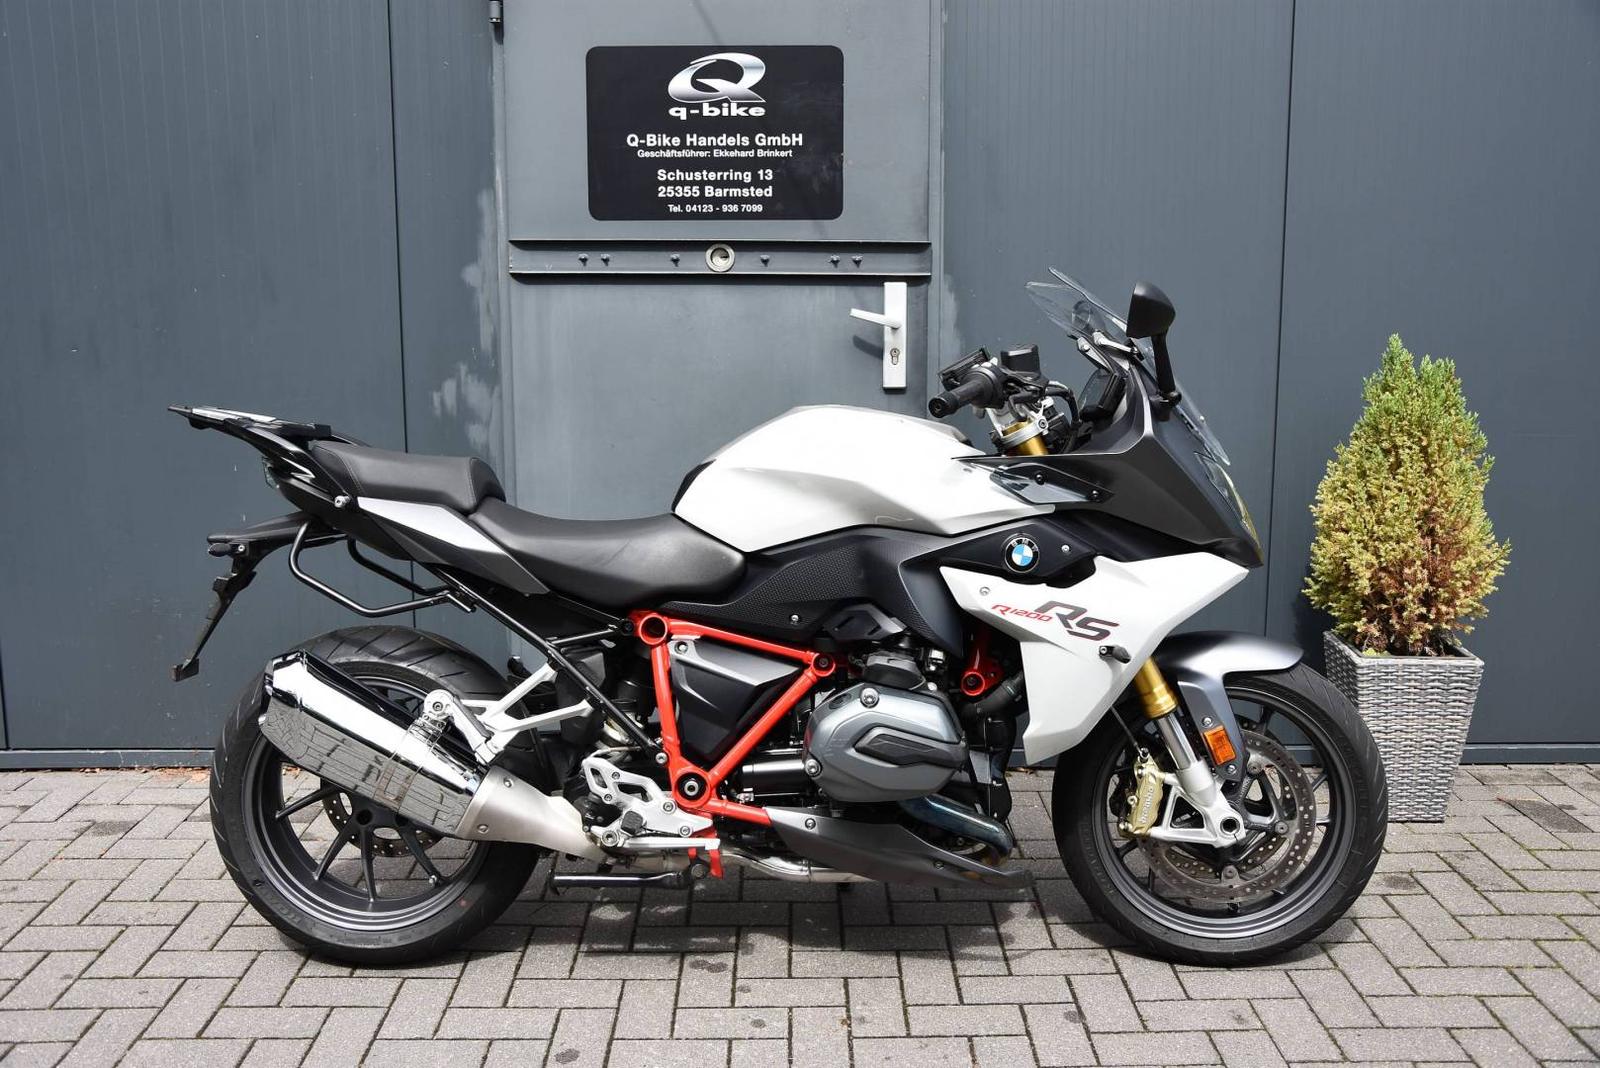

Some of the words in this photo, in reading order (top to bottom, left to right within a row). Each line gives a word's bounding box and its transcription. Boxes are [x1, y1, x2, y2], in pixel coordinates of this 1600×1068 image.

[668, 103, 766, 120] q-bike
[626, 133, 681, 147] Q-Bike
[686, 133, 750, 146] Handels
[755, 133, 803, 146] GmbH
[637, 148, 711, 158] Geschäftsführer:
[713, 148, 755, 158] Ekkehard
[757, 148, 793, 158] Brinkert
[657, 169, 752, 183] Schusterring
[757, 169, 773, 181] 13
[657, 186, 701, 197] 25355
[704, 186, 773, 197] Barmsted
[668, 204, 684, 212] Tel.
[685, 204, 714, 212] 04123
[721, 204, 739, 212] 936
[741, 204, 763, 212] 7099
[991, 604, 1053, 622] R1200
[1034, 600, 1120, 642] RS
